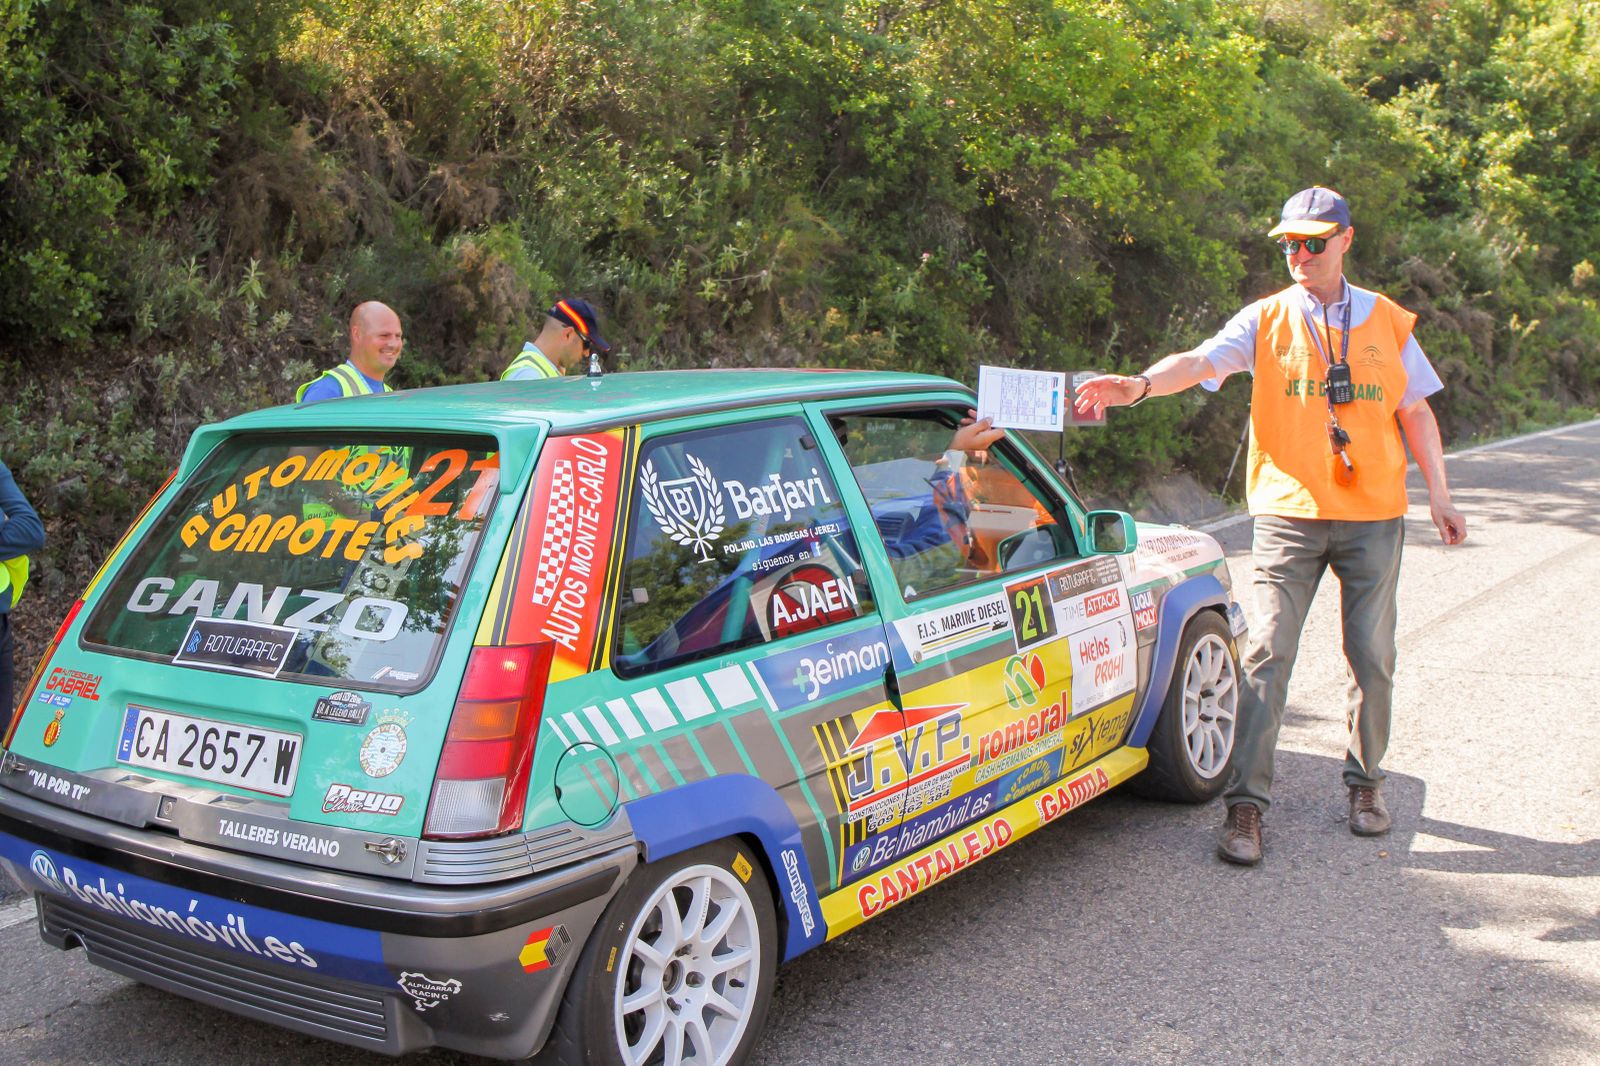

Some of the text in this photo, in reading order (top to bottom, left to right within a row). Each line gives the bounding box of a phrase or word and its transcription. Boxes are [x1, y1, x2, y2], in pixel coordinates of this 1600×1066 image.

[1285, 379, 1315, 397] JEFE
[403, 449, 500, 521] 21
[669, 485, 700, 521] BJ
[539, 437, 609, 651] AUTOS MONTE-CARLO
[723, 541, 758, 555] POL.IND.
[759, 536, 774, 548] LAS
[775, 529, 810, 545] BODEGAS
[814, 524, 836, 536] JEREZ
[798, 550, 810, 561] en
[126, 577, 409, 642] GANZO
[772, 576, 859, 628] A.JAEN
[917, 599, 1007, 640] F.I.S. MARINE DIESEL
[1015, 585, 1048, 641] 21
[1062, 591, 1119, 622] TIME ATTACK
[1131, 592, 1155, 611] LIQUI
[1135, 607, 1157, 628] MOLY
[203, 634, 284, 662] ROTUGRAFIC
[46, 666, 102, 701] GABRIEL
[1094, 653, 1124, 687] PROHI
[121, 739, 131, 752] E
[977, 690, 1068, 767] romeral
[135, 716, 297, 786] CA 2657 W
[848, 713, 971, 799] J.V.P.
[47, 775, 72, 796] POR
[849, 793, 900, 822] CONSTRUCCIONES
[931, 776, 939, 784] DE
[939, 764, 970, 783] MAQUINARIA
[867, 789, 951, 832] 609 562 384
[870, 792, 992, 867] Bahiamóvil.es
[218, 819, 340, 858] TALLERES VERANO
[857, 818, 1013, 919] CANTALEJO
[62, 865, 319, 969] Bahiamóvil.es
[407, 981, 453, 993] ALPUJARRA
